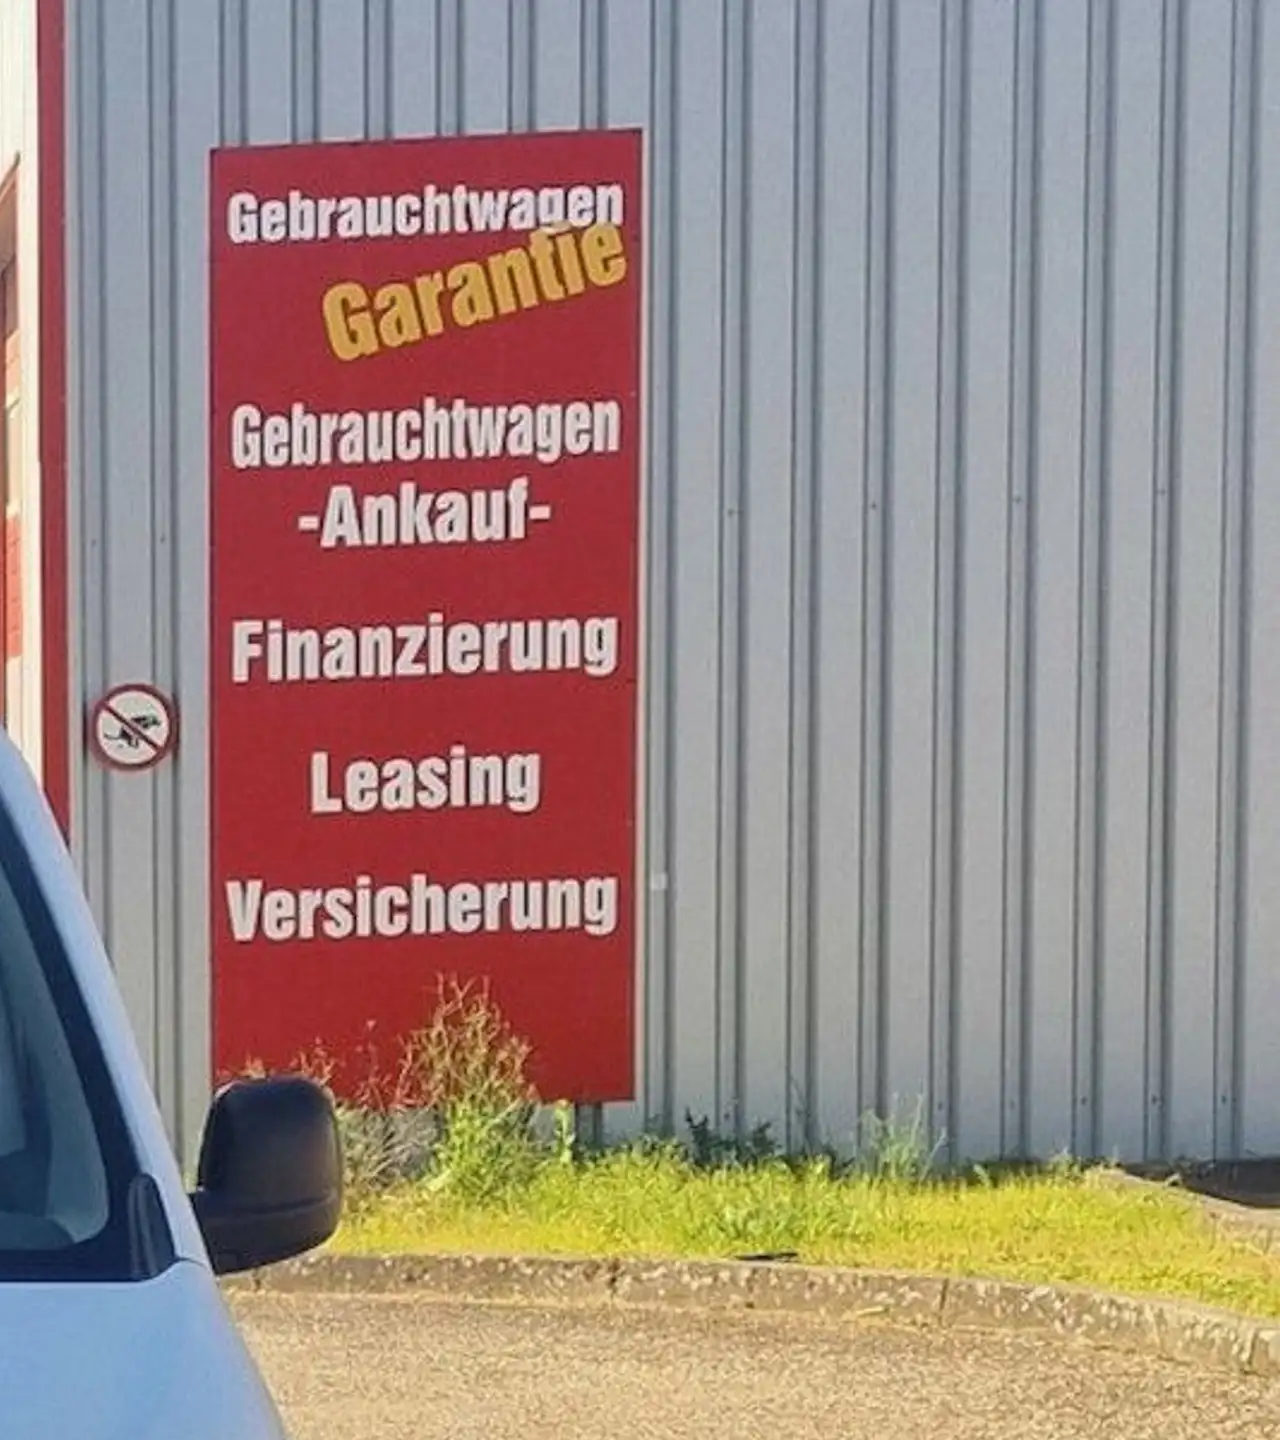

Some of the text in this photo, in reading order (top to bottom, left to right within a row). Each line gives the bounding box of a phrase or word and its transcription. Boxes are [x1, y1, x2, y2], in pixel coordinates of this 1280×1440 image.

[227, 184, 624, 244] Gebrauchtwagen
[322, 220, 628, 361] Garantie
[231, 396, 620, 469] Gebrauchtwagen
[298, 476, 551, 548] -Ankauf-
[231, 612, 618, 683] Finanzierung
[311, 745, 540, 813] Leasing
[225, 873, 618, 941] Versicherung
